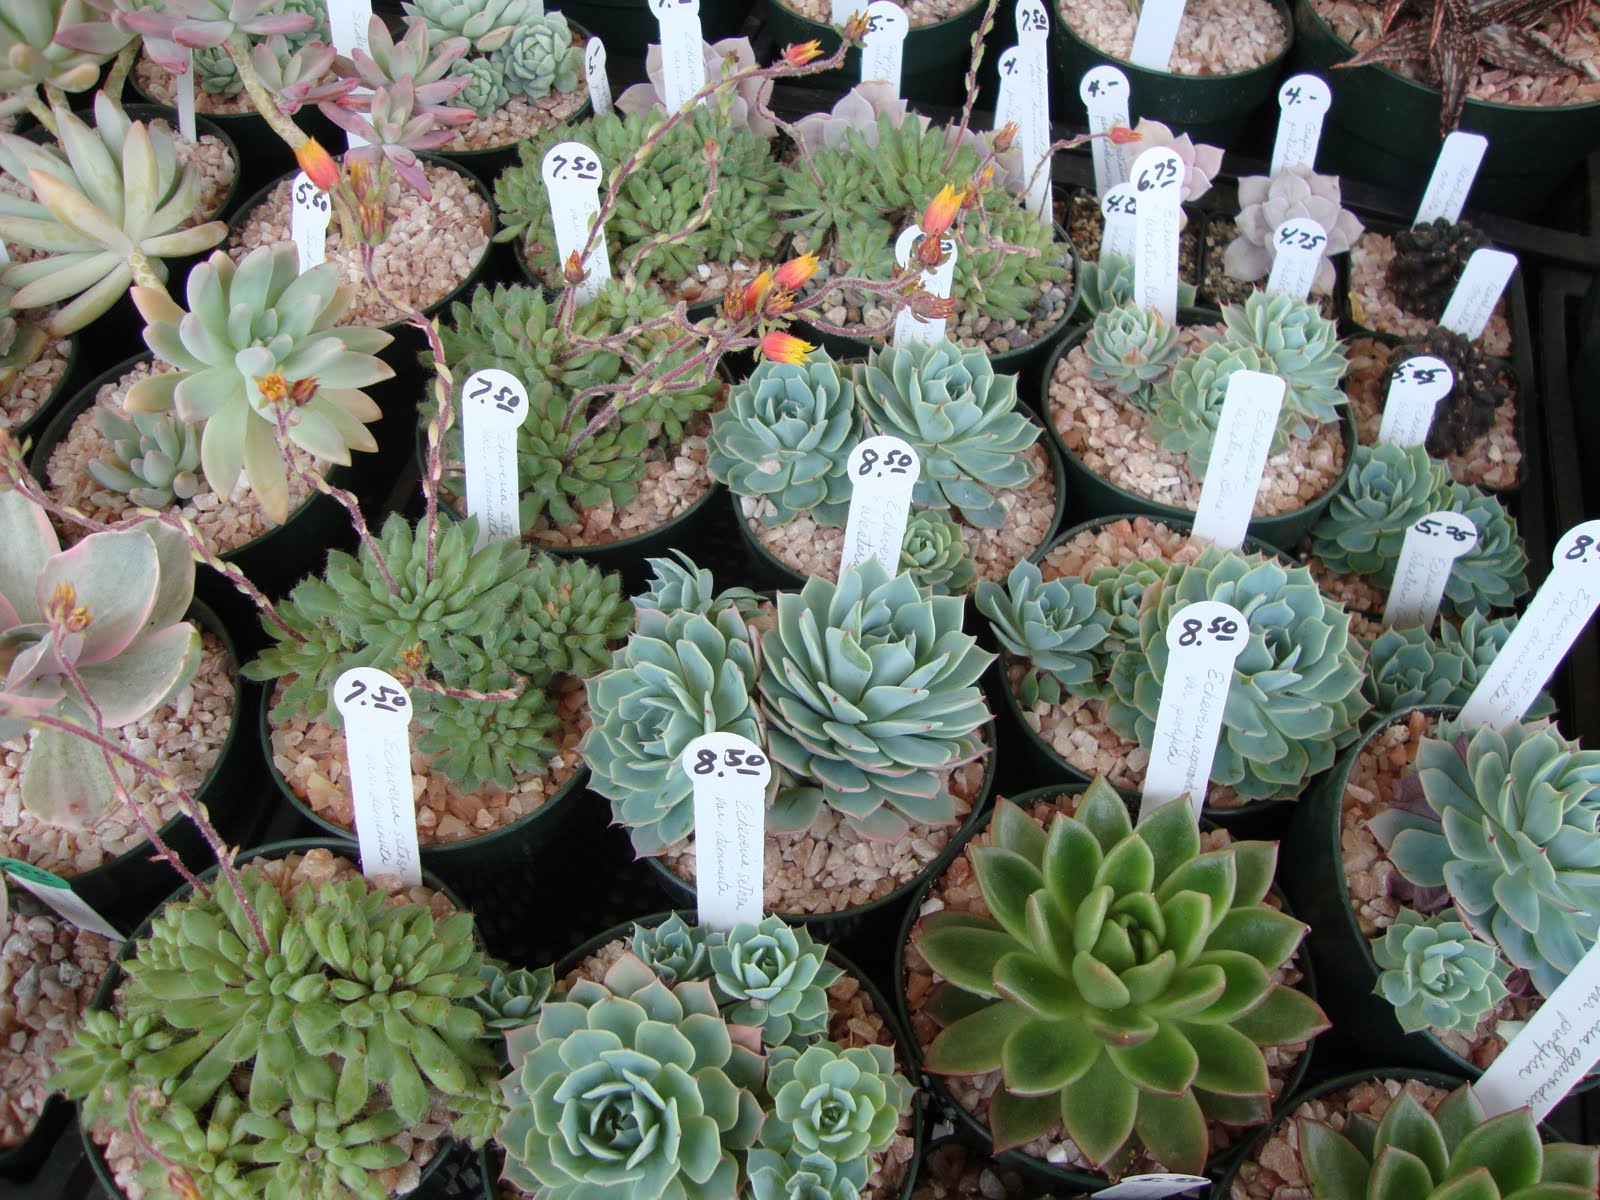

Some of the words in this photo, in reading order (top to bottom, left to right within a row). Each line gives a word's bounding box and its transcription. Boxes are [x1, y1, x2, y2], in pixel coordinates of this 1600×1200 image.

[1021, 8, 1047, 31] 7.50
[552, 155, 598, 180] 7.50
[1136, 158, 1178, 192] 6.75
[295, 182, 328, 212] 5.50
[1280, 227, 1326, 250] 4.75
[469, 377, 520, 413] 7.50
[858, 448, 913, 478] 8.50
[1415, 518, 1477, 542] 5.25
[1178, 616, 1239, 647] 8.50
[343, 679, 407, 713] 7.50
[693, 748, 766, 778] 8.50
